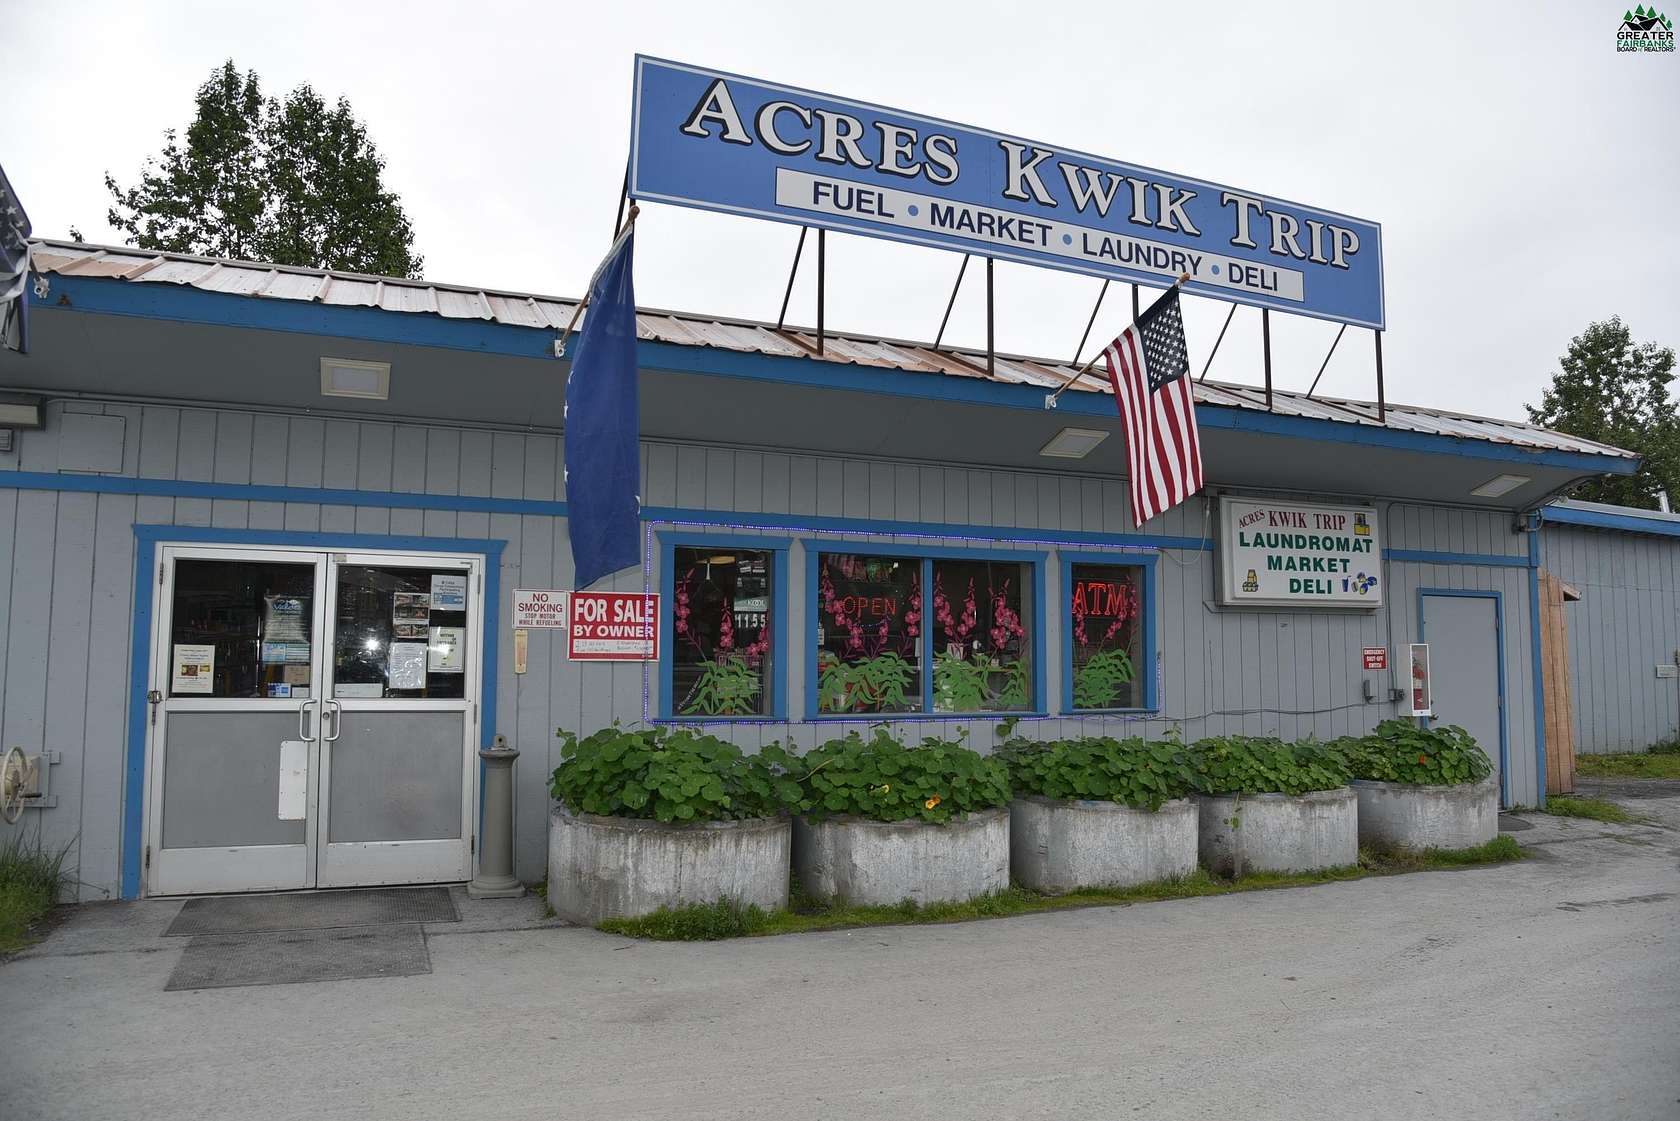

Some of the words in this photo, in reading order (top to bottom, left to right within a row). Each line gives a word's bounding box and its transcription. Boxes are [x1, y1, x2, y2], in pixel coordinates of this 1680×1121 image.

[680, 78, 960, 185] ACRES
[999, 140, 1201, 236] KWIK
[1221, 192, 1360, 269] TRIP
[813, 180, 895, 218] FUEL
[930, 202, 1053, 247] MARKET
[1083, 232, 1203, 276] LAUNDRY
[1228, 262, 1278, 291] DELI
[1238, 509, 1265, 528] ACRES
[1268, 510, 1308, 528] KWIK
[1313, 513, 1346, 530] TRIP
[1239, 531, 1373, 553] LAUNDROMAT
[1267, 555, 1350, 573] MARKET
[1289, 578, 1332, 594] DELI
[518, 602, 563, 613] SMOKING
[532, 593, 549, 602] NO
[843, 596, 896, 617] OPEN
[1072, 582, 1127, 616] ATM
[574, 598, 607, 622] FOR
[613, 599, 654, 623] SALE
[573, 625, 592, 637] BY
[597, 626, 654, 637] OWNER
